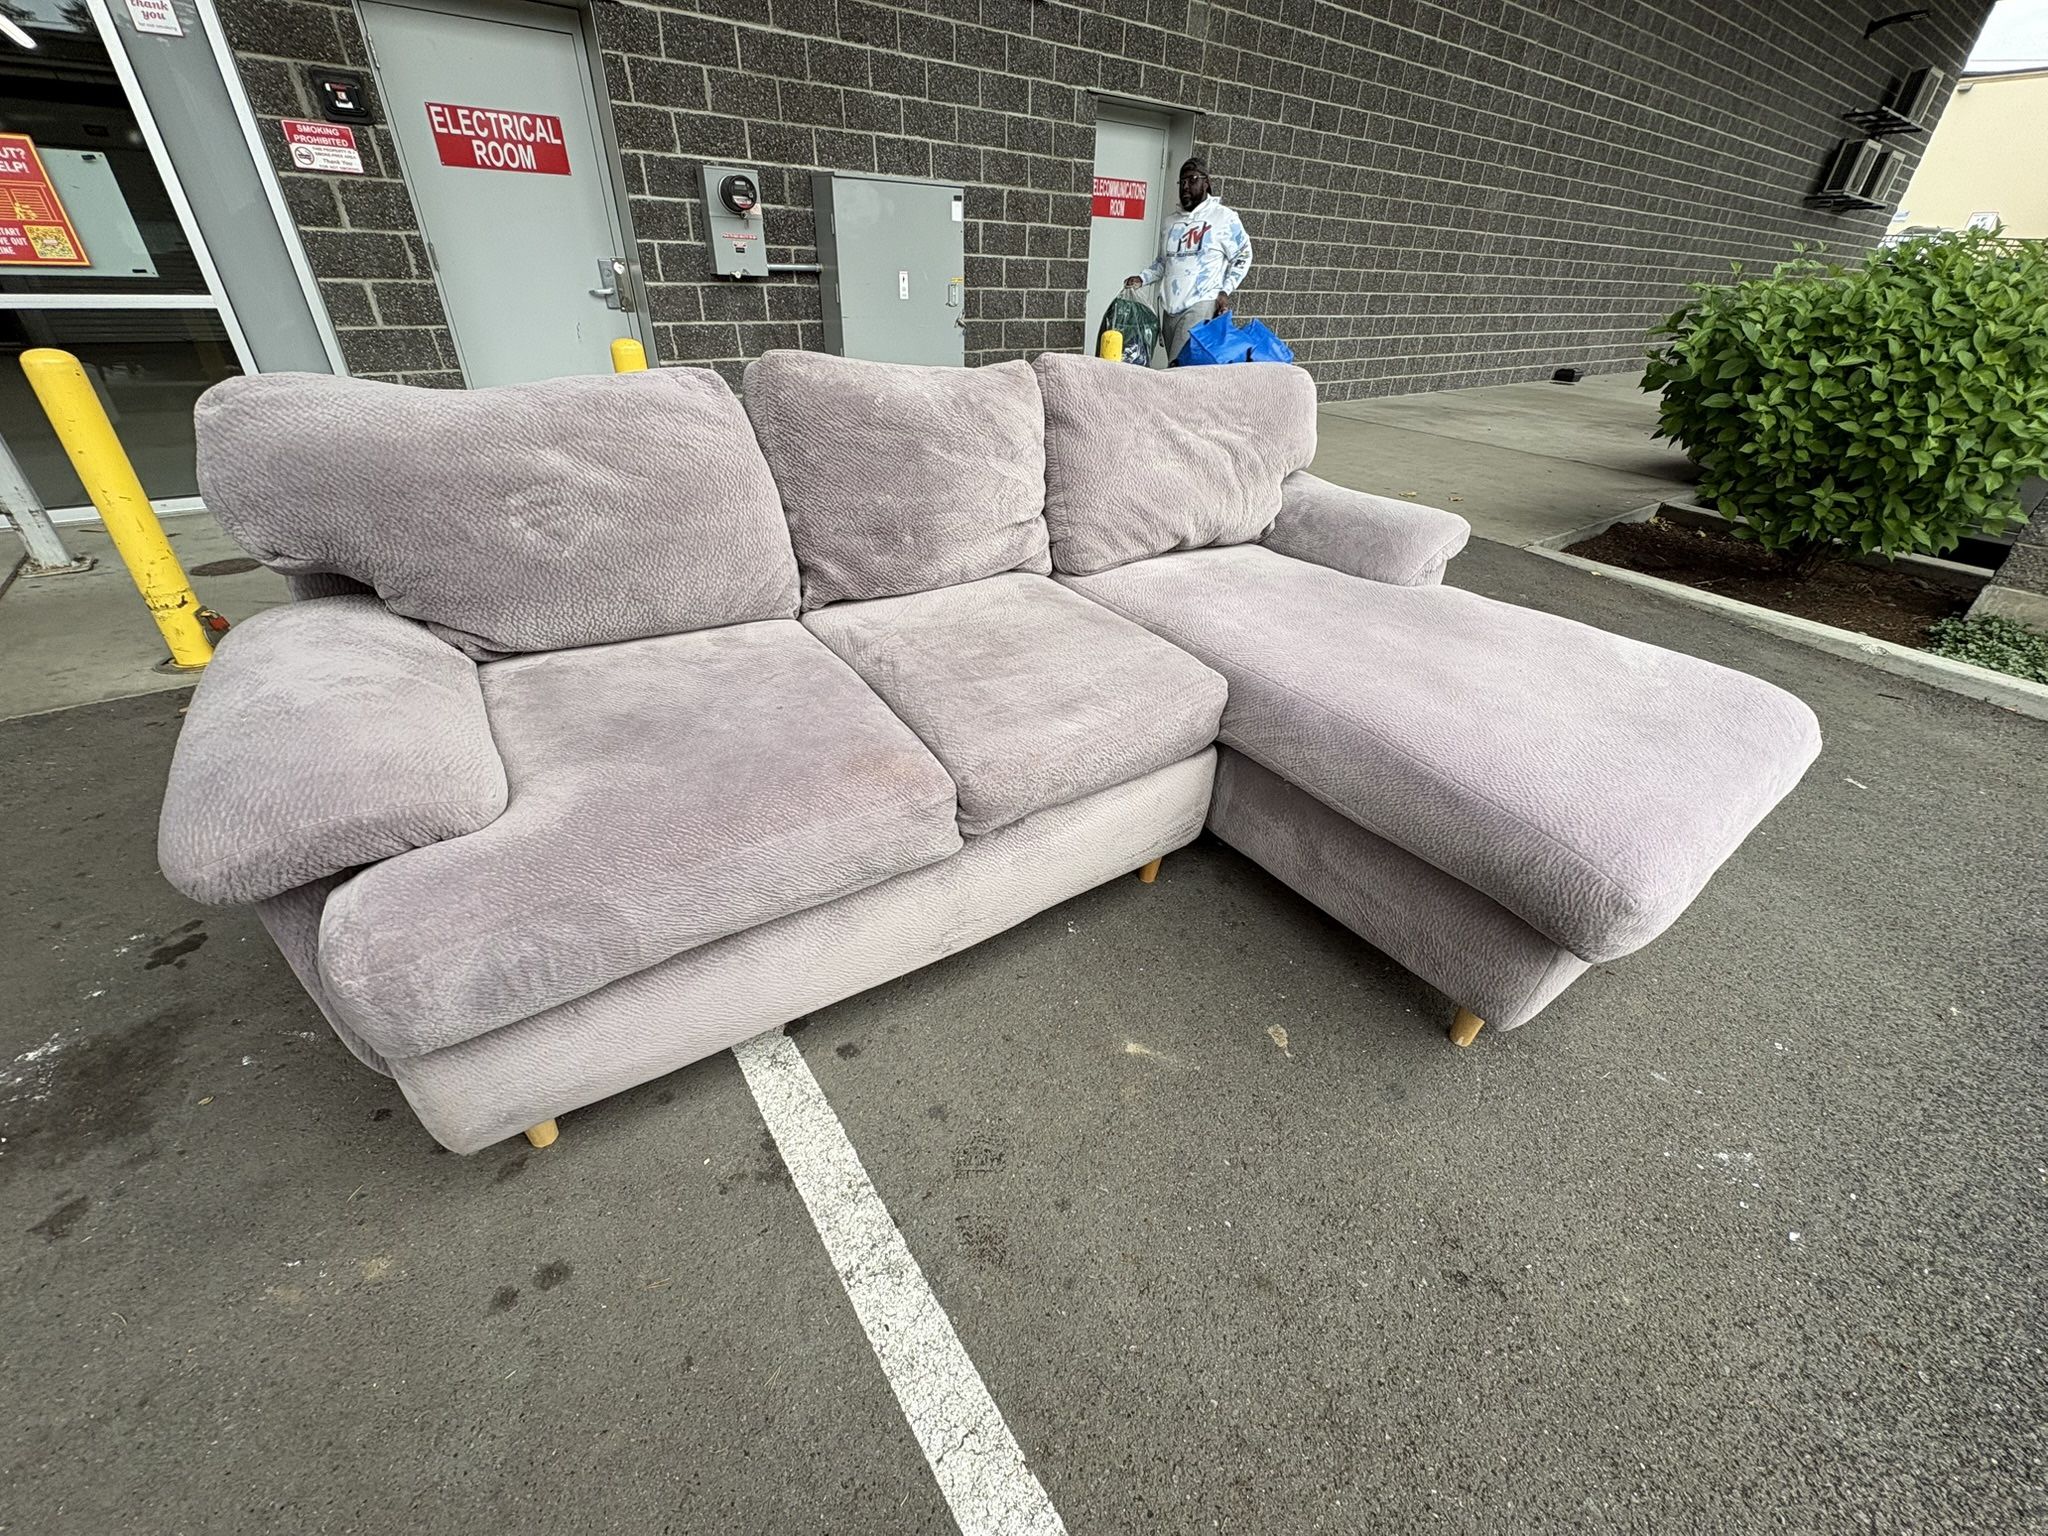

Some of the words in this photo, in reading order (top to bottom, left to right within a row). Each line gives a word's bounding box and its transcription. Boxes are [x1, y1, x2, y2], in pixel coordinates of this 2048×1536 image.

[131, 0, 169, 11] thank
[141, 10, 166, 20] you
[295, 124, 340, 136] SMOKING
[429, 105, 562, 144] ELECTRICAL
[293, 134, 349, 147] PROHIBITED
[0, 146, 26, 160] UT?
[471, 139, 537, 170] ROOM
[0, 160, 30, 173] ELP!
[1093, 178, 1146, 200] ELECOMMUNICATIONS
[1110, 199, 1125, 217] ROOM
[0, 227, 21, 236] TART
[10, 236, 28, 246] OUT
